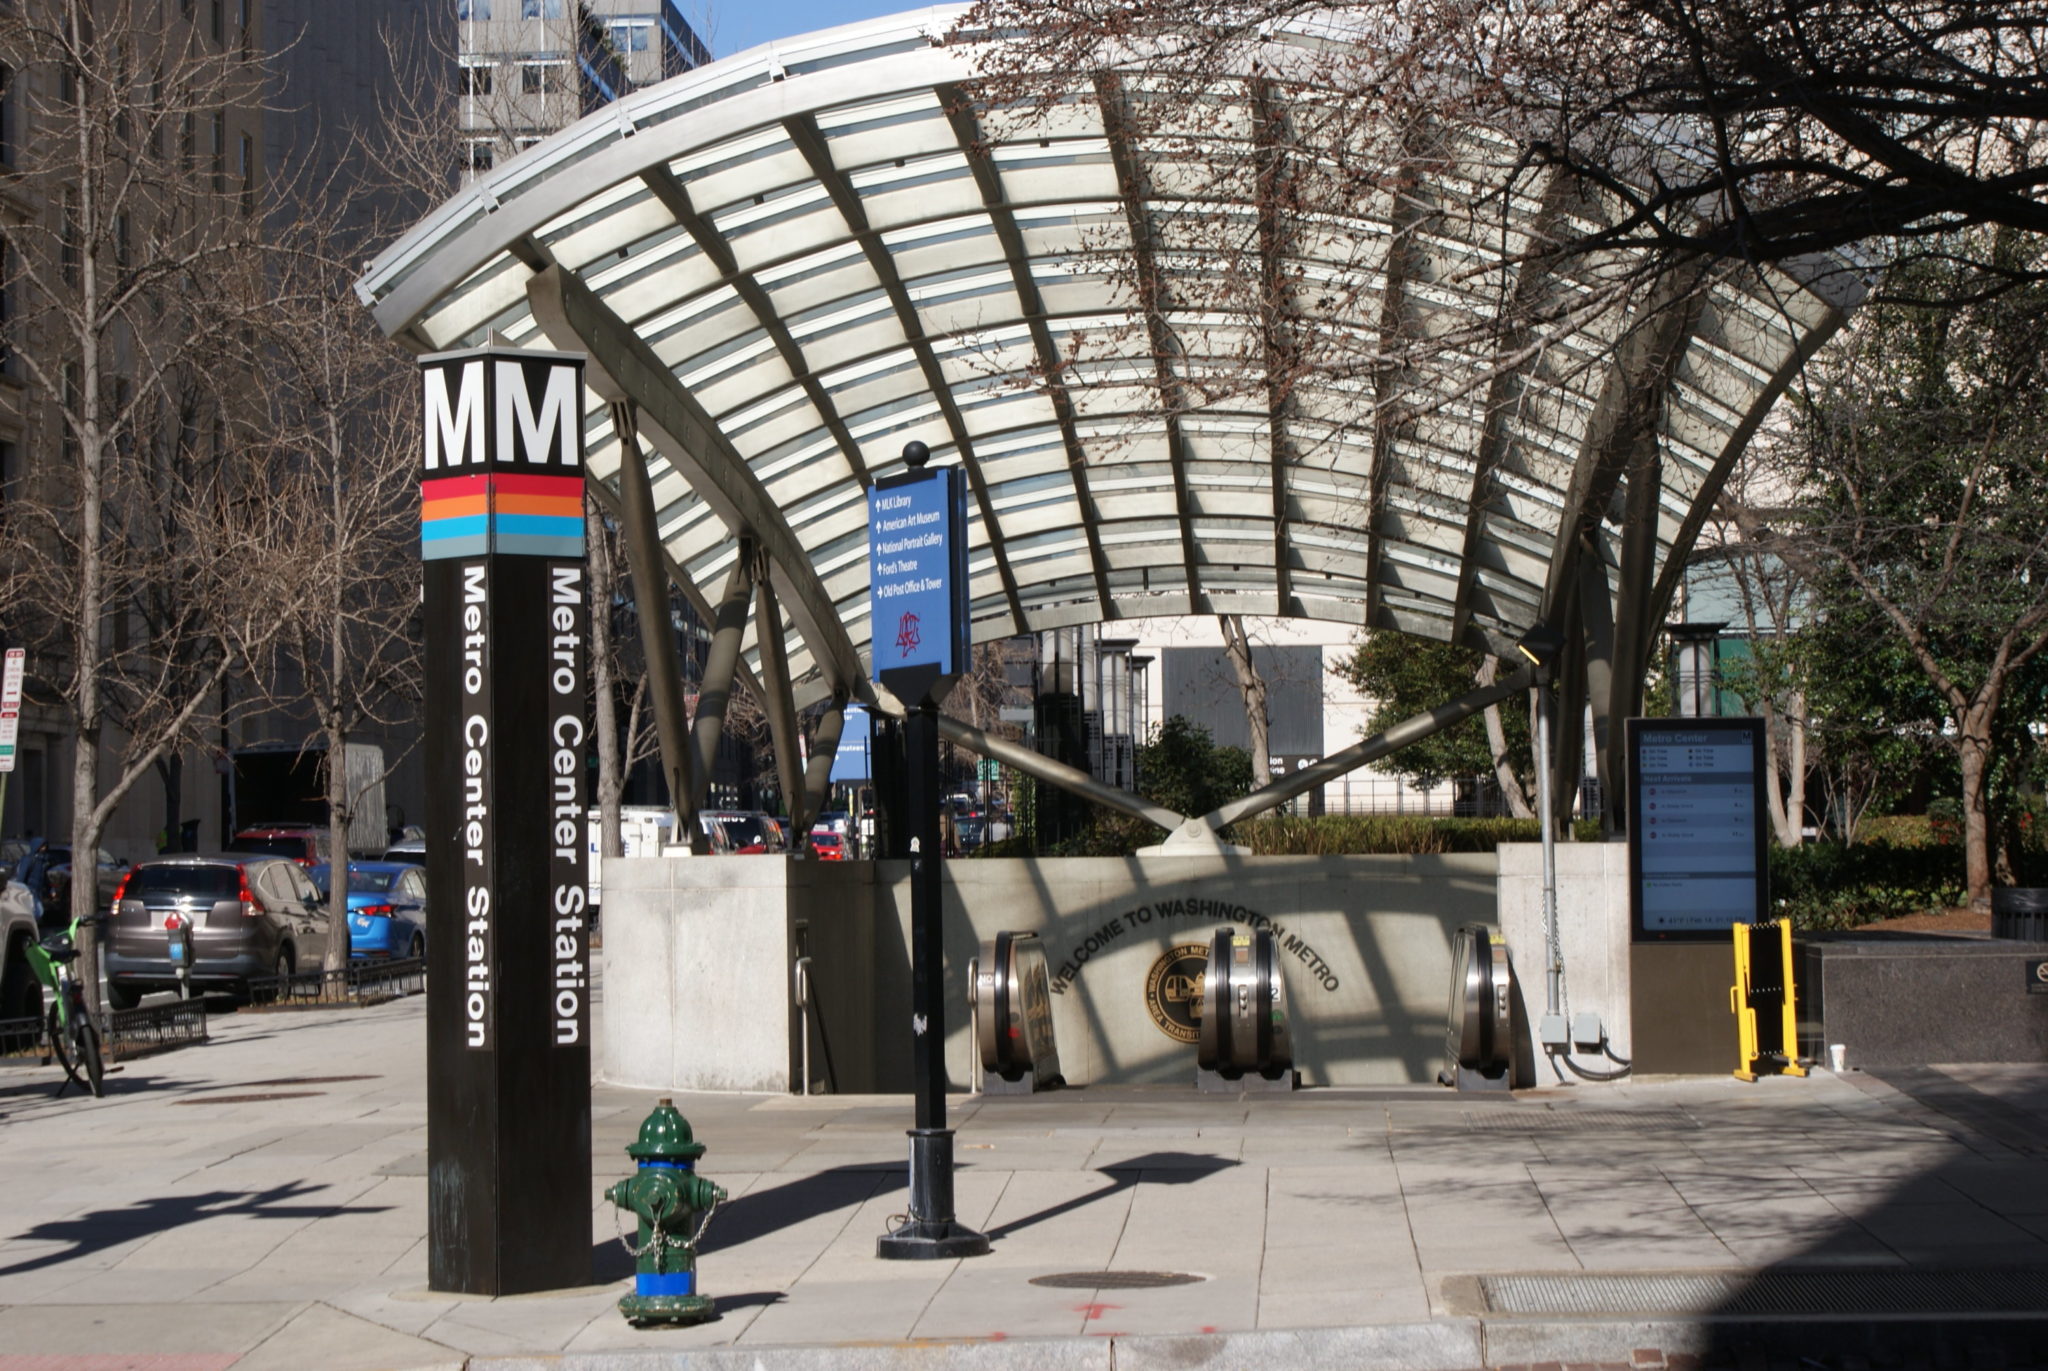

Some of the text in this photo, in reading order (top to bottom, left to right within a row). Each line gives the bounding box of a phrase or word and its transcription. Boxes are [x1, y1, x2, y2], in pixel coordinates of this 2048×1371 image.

[424, 361, 486, 470] M
[495, 360, 579, 466] M
[881, 494, 912, 511] MLK Library
[882, 511, 940, 532] American Art Museum
[882, 532, 943, 555] National Portrait Gallery
[883, 559, 918, 576] Ford's Theatre
[883, 577, 943, 598] Old Post Office & Tower
[1643, 734, 1708, 743] Metro Center
[464, 565, 490, 1048] Metro Center Station
[552, 567, 585, 1045] Metro Center Station
[1050, 897, 1340, 996] WELCOME TO WASHINGTON METRO
[1148, 945, 1210, 992] WASHINGTON MET
[1148, 1000, 1164, 1024] AREA
